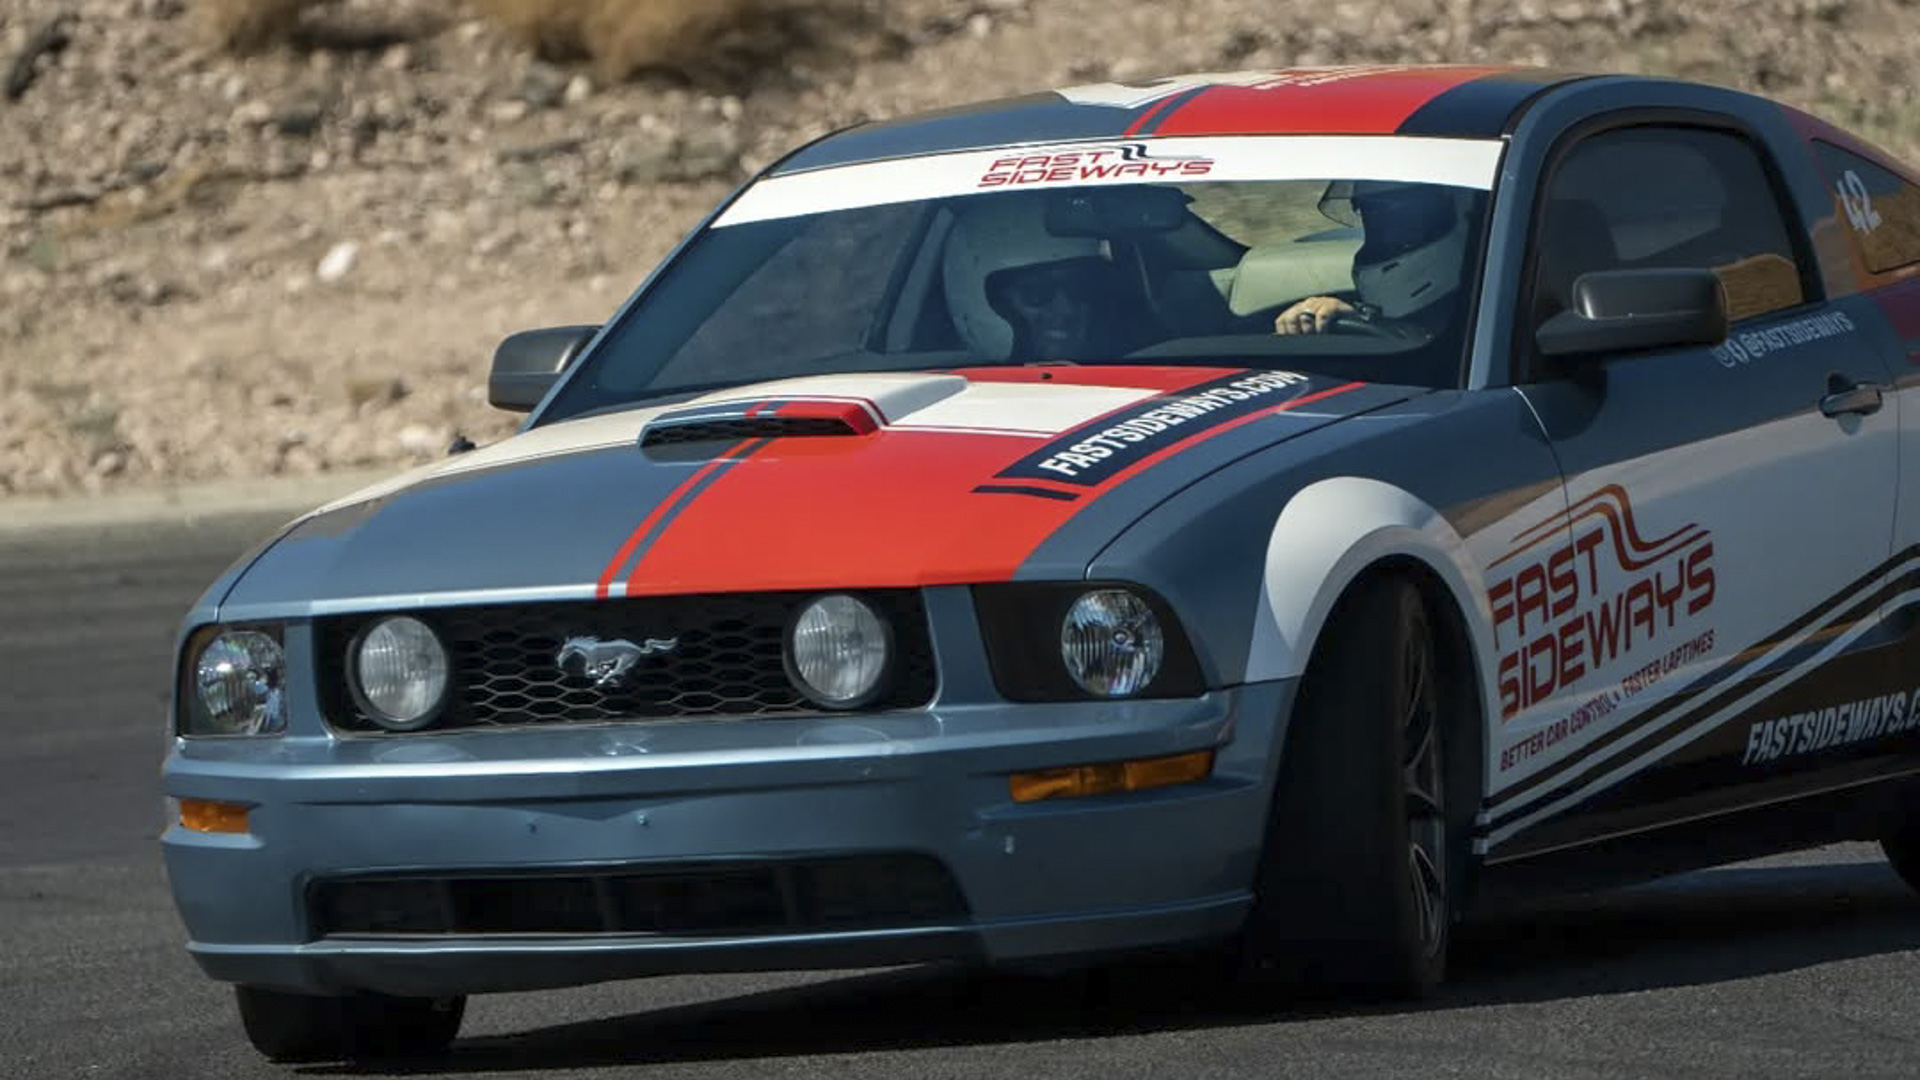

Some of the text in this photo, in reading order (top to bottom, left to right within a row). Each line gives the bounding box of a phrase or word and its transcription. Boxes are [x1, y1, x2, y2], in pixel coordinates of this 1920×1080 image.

[977, 160, 1214, 188] SIDEWAYS
[989, 151, 1115, 172] FAST
[1039, 371, 1309, 476] FASTSIDEWAYS.COM
[1487, 527, 1604, 650] FAST
[1498, 541, 1715, 721] SIDEWAYS
[1500, 629, 1714, 771] BETTER CAR CONTROL FASTER LAPTIMES
[1742, 688, 1920, 765] FASTSIDEWAYS.C
